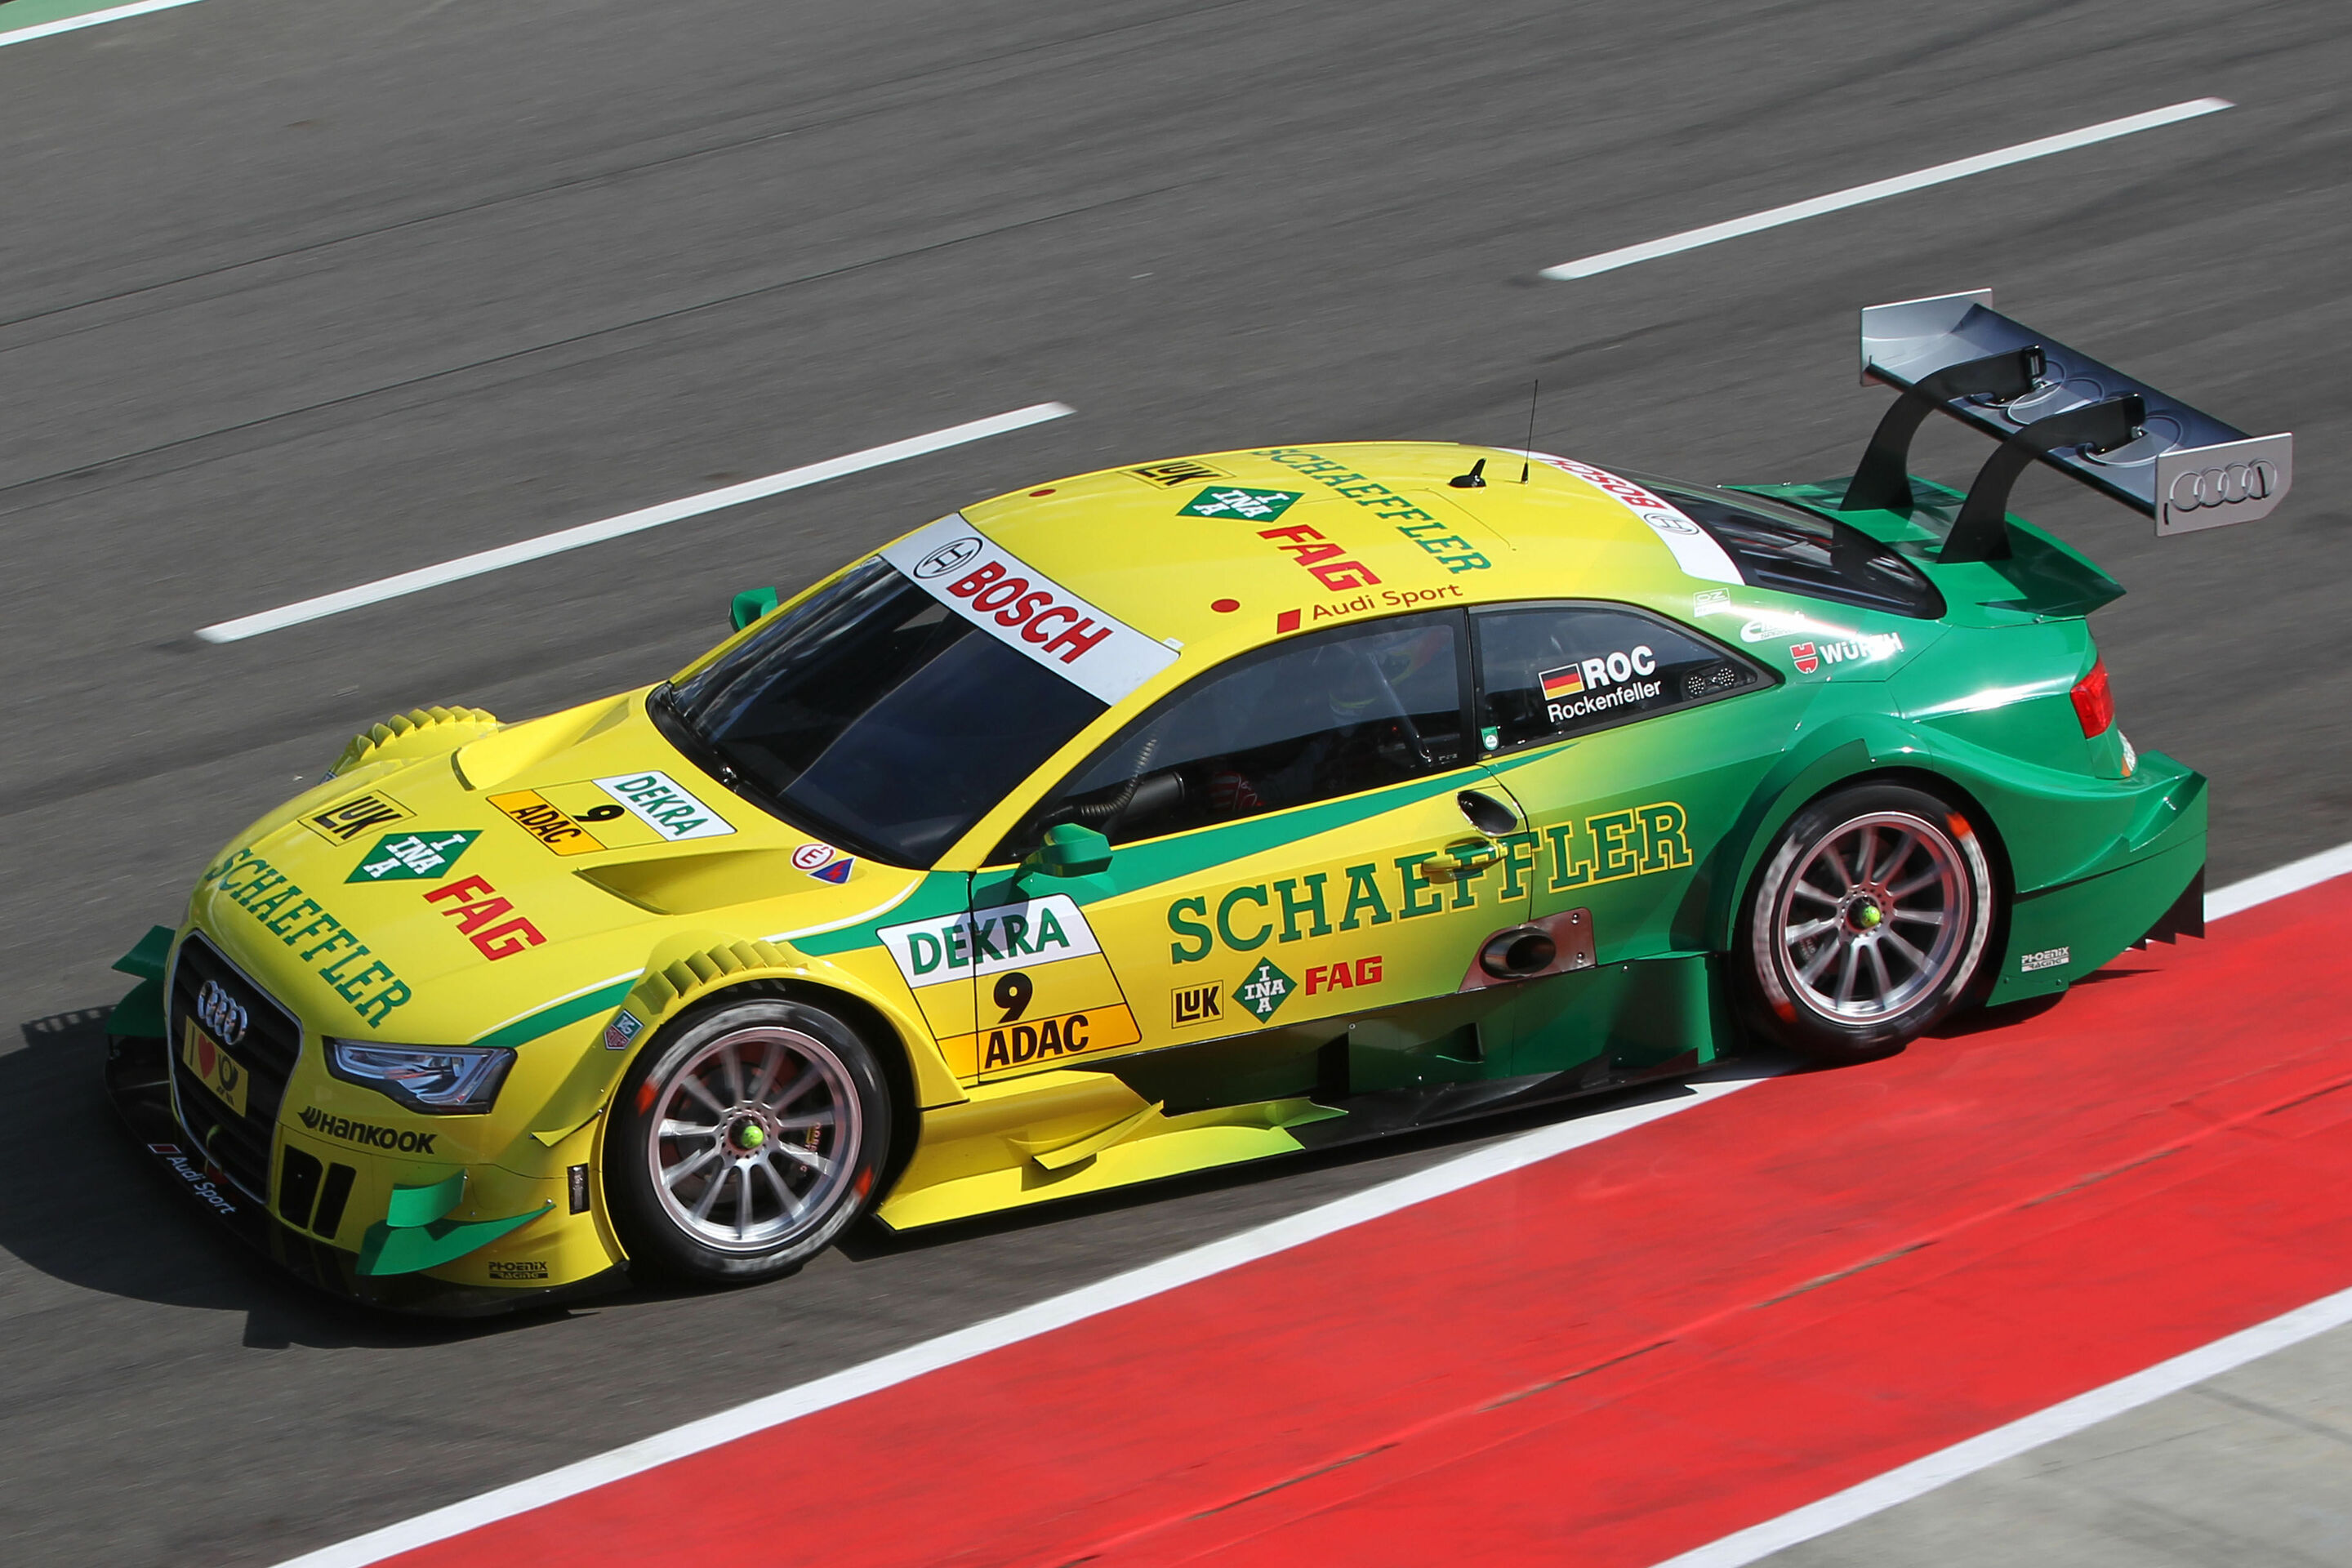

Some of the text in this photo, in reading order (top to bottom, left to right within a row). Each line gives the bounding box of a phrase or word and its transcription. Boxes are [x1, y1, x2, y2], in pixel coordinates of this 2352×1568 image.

[1251, 448, 1491, 574] SCHAEFFLER
[1536, 458, 1668, 510] BOSCH
[1257, 523, 1382, 591] FAG
[946, 561, 1114, 664] BOSCH
[1313, 584, 1463, 621] Audi Sport
[1582, 645, 1655, 689] ROC
[1548, 681, 1661, 723] Rockenfeller
[510, 804, 581, 844] ADAC
[572, 804, 625, 822] 9
[614, 775, 708, 836] DEKRA
[1168, 802, 1693, 964] SCHAEFFLER
[207, 847, 412, 1029] SCHAEFFLER
[423, 875, 547, 961] FAG
[906, 907, 1071, 975] DEKRA
[993, 972, 1033, 1024] 9
[1306, 956, 1382, 996] FAG
[984, 1014, 1089, 1069] ADAC
[166, 1156, 236, 1214] Audi Sport
